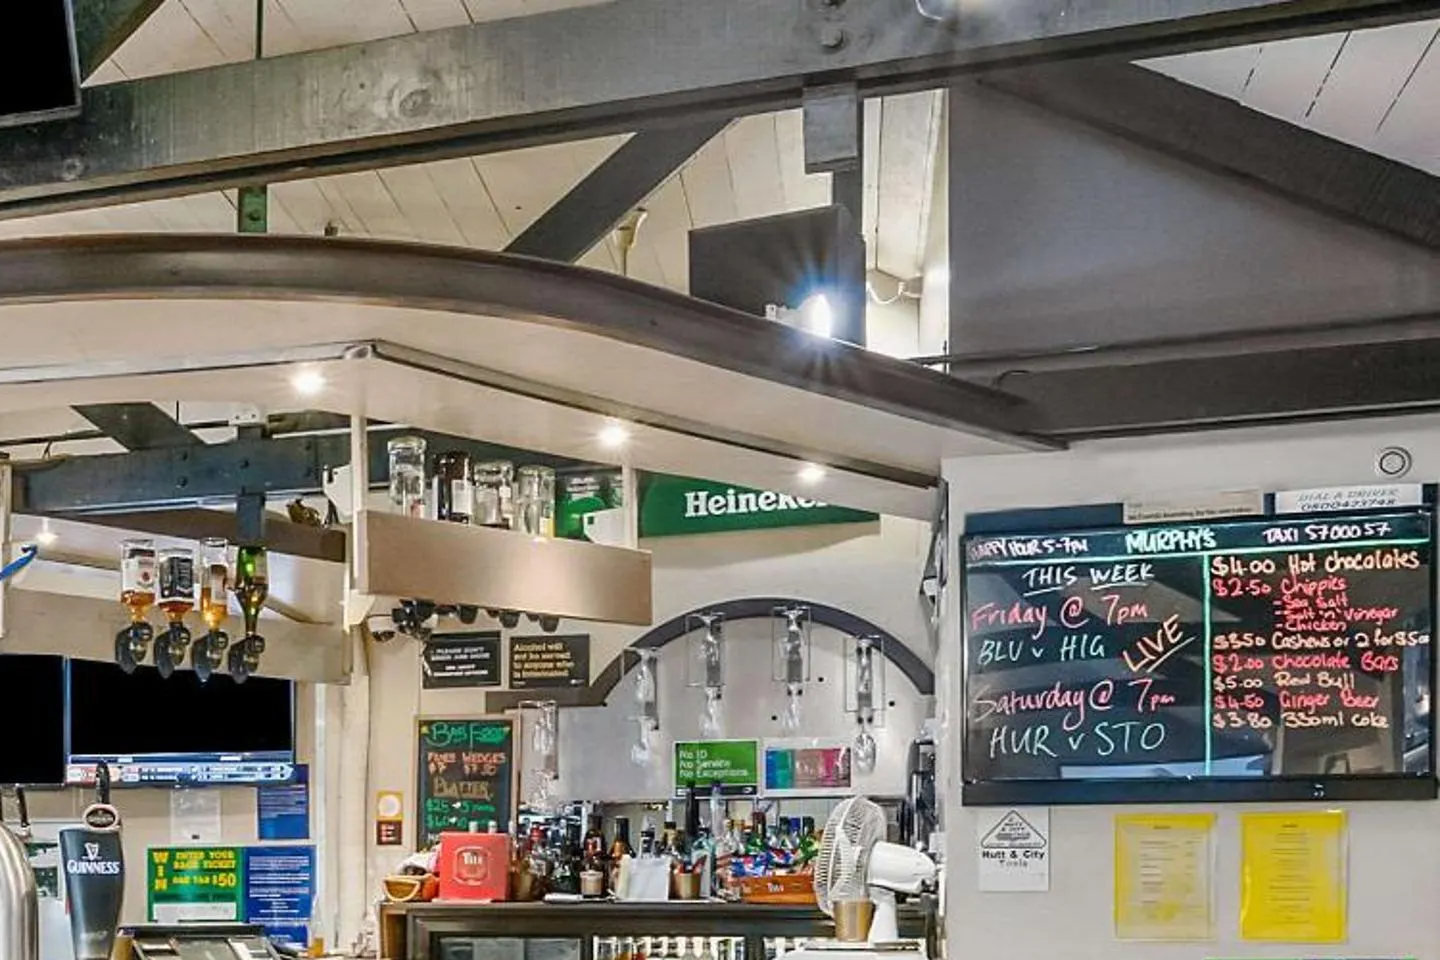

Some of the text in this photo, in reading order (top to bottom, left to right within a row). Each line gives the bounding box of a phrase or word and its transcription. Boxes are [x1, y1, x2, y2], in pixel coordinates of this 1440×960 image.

[1124, 527, 1216, 553] MURPHY'S
[1262, 527, 1299, 544] TAXI
[1022, 562, 1156, 588] THIS WEEK
[971, 602, 1048, 640] Friday
[1060, 596, 1090, 628] @
[978, 639, 1022, 666] BLU
[1061, 634, 1105, 660] HIG
[1122, 613, 1184, 672] LIVE
[1355, 632, 1370, 647] 2
[1274, 671, 1310, 687] Red
[1318, 671, 1355, 690] Bull
[975, 681, 1085, 731] Saturday
[1089, 680, 1114, 710] @
[1279, 691, 1330, 712] Ginger
[1340, 689, 1379, 708] Beer
[990, 724, 1059, 759] HUR
[1095, 722, 1165, 756] STO
[67, 860, 120, 874] GUINNESS
